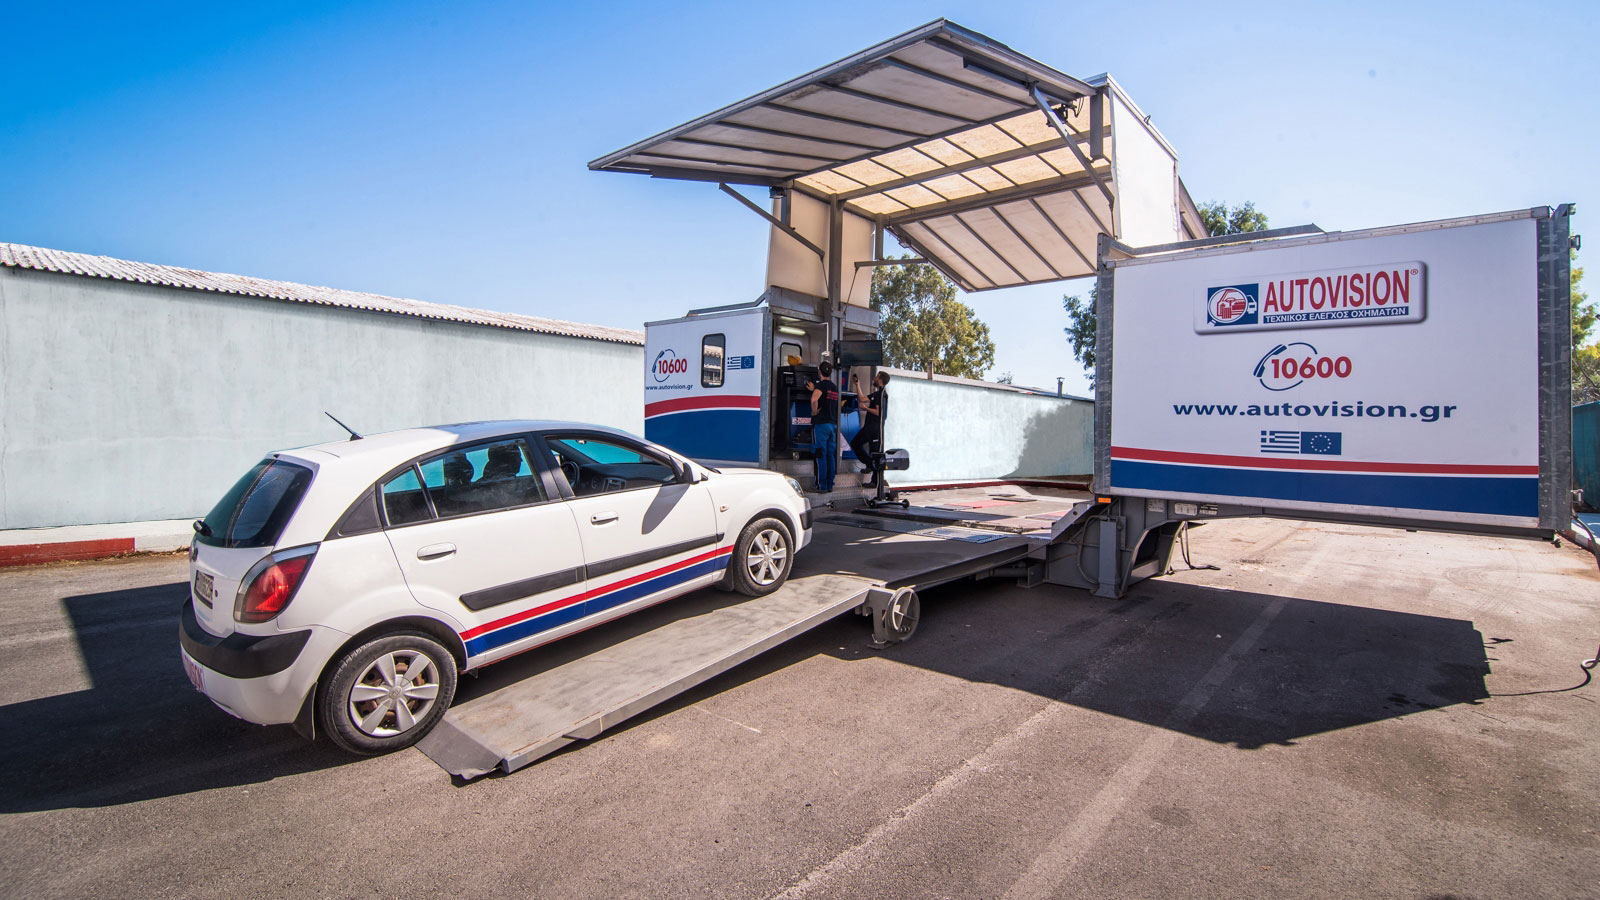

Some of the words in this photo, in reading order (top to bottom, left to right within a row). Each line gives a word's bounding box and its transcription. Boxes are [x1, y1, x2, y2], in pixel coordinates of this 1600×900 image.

[1265, 313, 1308, 323] ΤΕΧΝΙΚΟΣ
[1309, 310, 1349, 321] ΕΛΕΓΧΟΣ
[1350, 307, 1407, 318] ΟΧΗΜΑΤΩΝ
[658, 358, 687, 374] 10600
[1271, 356, 1352, 379] 10600
[1173, 400, 1457, 422] www.autovision.gr
